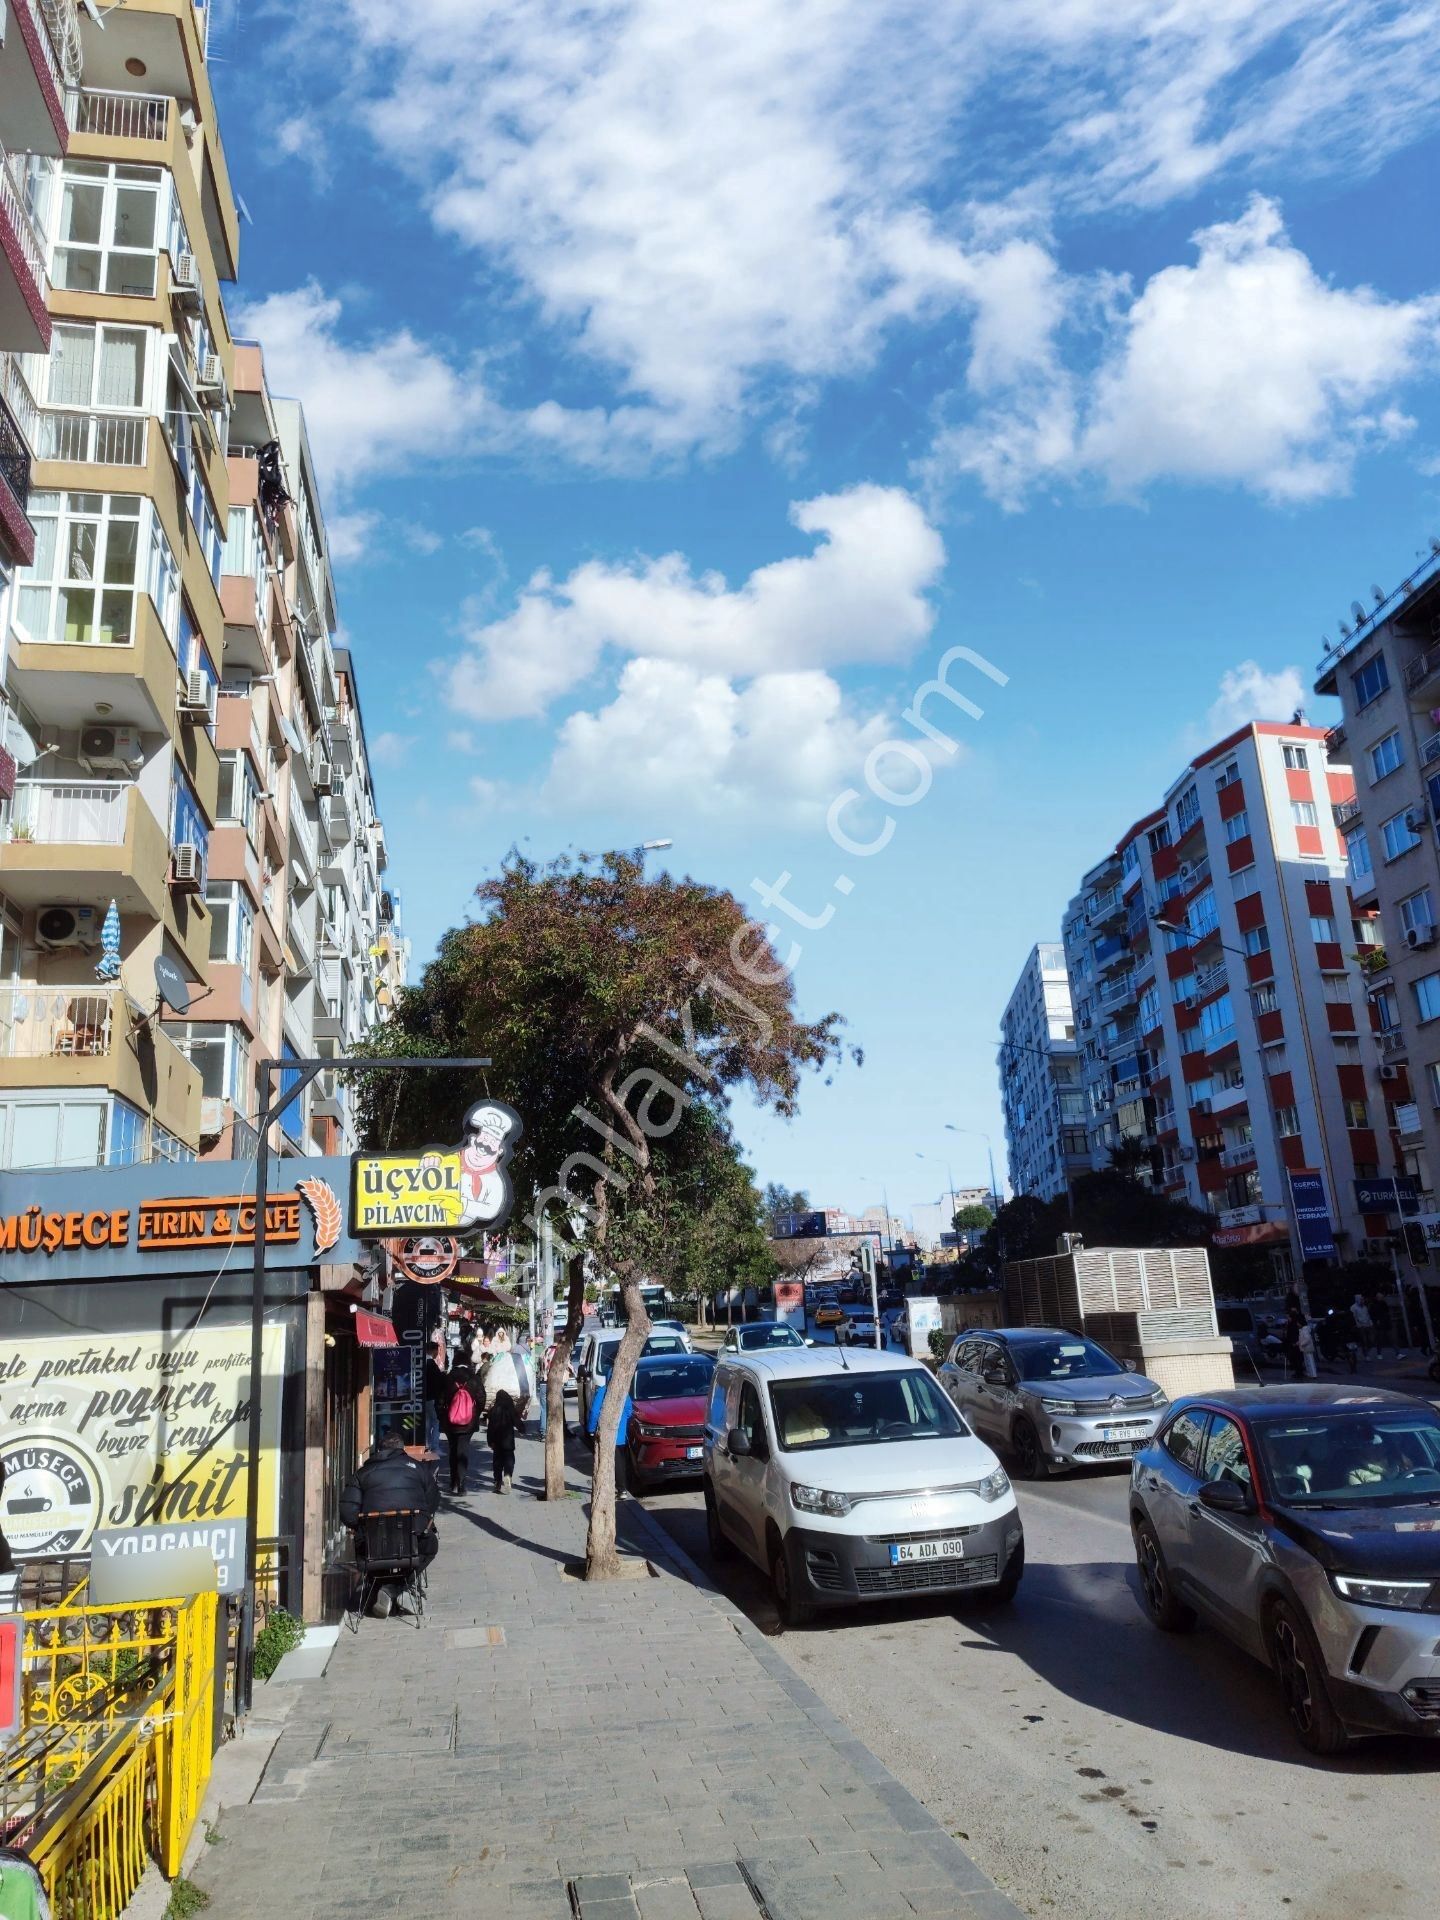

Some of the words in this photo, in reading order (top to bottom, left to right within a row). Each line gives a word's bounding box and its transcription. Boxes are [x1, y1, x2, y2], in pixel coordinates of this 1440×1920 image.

[363, 1163, 459, 1200] ÜÇYOL
[1372, 1190, 1415, 1201] TURKCELL
[139, 1210, 205, 1236] FIRIN
[212, 1208, 232, 1233] &
[239, 1206, 300, 1230] CAFE
[364, 1201, 446, 1225] PİLAVCIM
[31, 1346, 142, 1388] portakal
[145, 1350, 200, 1377] suyu
[10, 1401, 67, 1425] açma
[96, 1430, 150, 1458] boyoz
[167, 1424, 215, 1456] çay
[109, 1452, 262, 1525] simit
[900, 1547, 913, 1558] 64
[920, 1544, 937, 1557] ADA
[943, 1541, 960, 1554] 090
